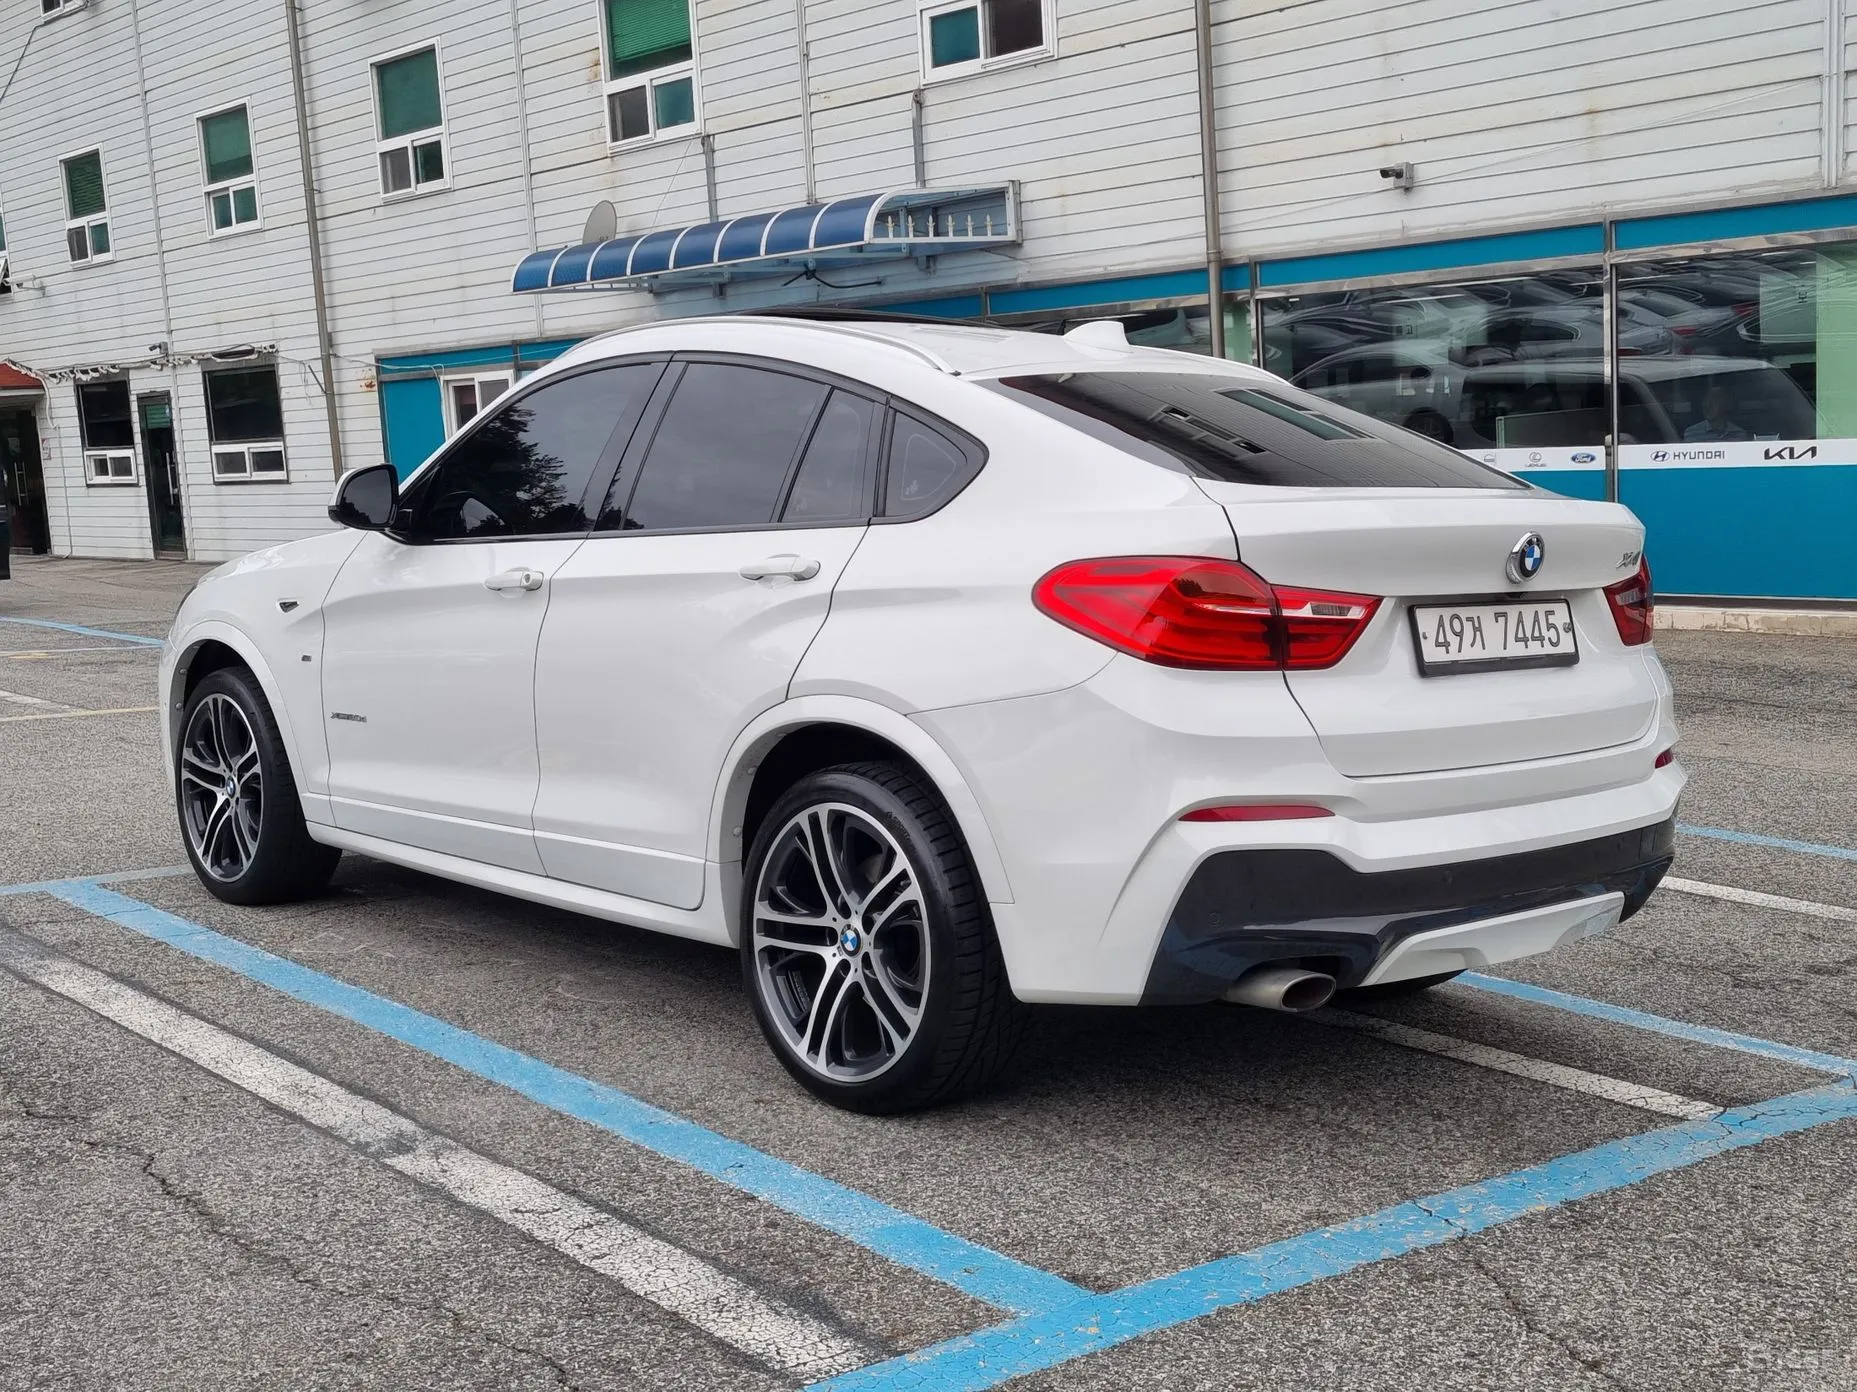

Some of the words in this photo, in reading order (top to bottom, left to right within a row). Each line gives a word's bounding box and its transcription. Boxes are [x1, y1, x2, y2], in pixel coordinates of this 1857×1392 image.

[1673, 451, 1725, 460] HYUNDAI
[1764, 446, 1817, 460] KIA
[1434, 613, 1486, 654] 49거
[1494, 610, 1561, 650] 7445
